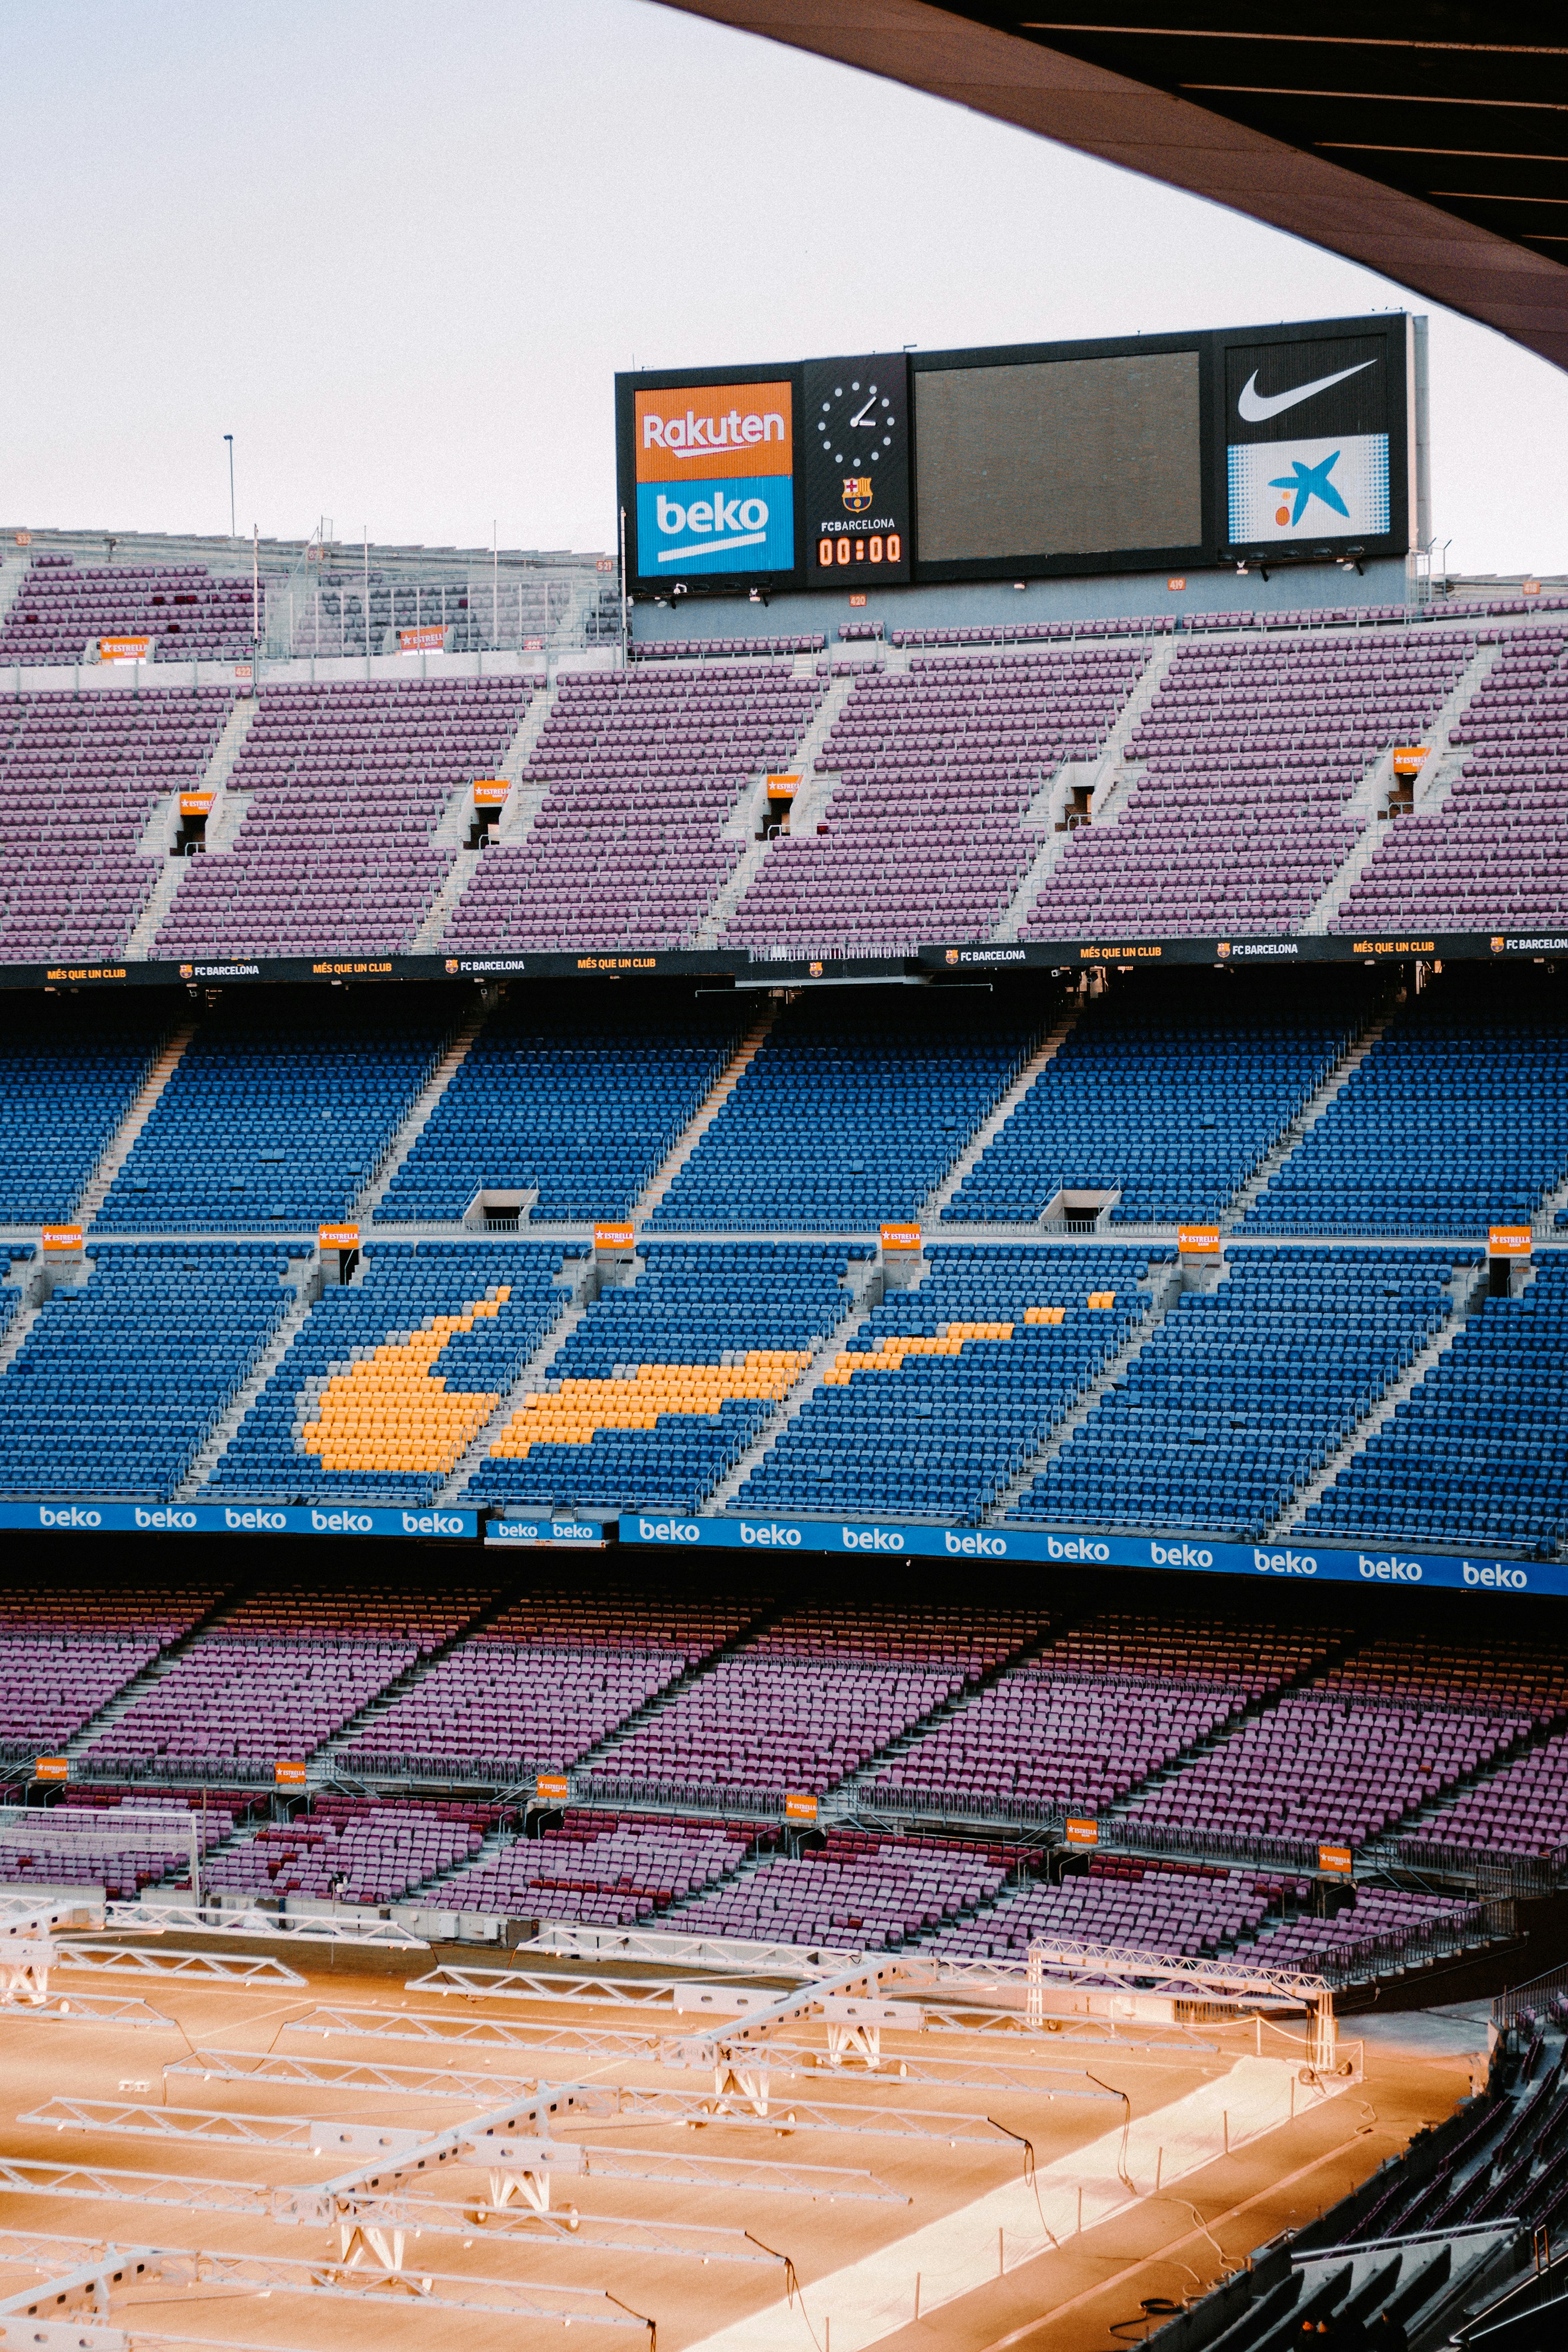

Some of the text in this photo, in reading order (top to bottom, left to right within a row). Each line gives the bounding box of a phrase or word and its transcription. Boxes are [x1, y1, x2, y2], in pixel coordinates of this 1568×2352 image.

[643, 410, 784, 449] Rakuten
[657, 492, 769, 534] beko
[820, 534, 900, 566] 00:00
[1169, 580, 1183, 589] 419
[851, 596, 865, 606] 420
[236, 667, 251, 676] 422
[1081, 946, 1161, 959] MÉS QUE UN CLUB
[1233, 944, 1298, 955] FC BARCELONA
[1353, 940, 1435, 954] MÉS QUE UN CLUB
[1507, 938, 1568, 949] FC BARCELON
[460, 960, 524, 971] FC BARCELONA
[577, 957, 656, 970] MÉS QUE UN CLUB
[961, 950, 1025, 961] FC BARCELONA
[47, 968, 126, 981] MÉS QUE UN CLUB
[195, 965, 259, 975] FC BARCELONA
[313, 962, 392, 974] MÉS QUE UN CLUB
[40, 1506, 102, 1527] beko
[135, 1508, 197, 1528] beko
[225, 1508, 286, 1529] beko
[311, 1510, 373, 1531] beko
[402, 1512, 463, 1534] beko
[499, 1523, 538, 1538] beko
[553, 1523, 593, 1538] beko
[639, 1518, 700, 1542] beko
[740, 1523, 801, 1546] beko
[842, 1527, 904, 1551] beko
[945, 1531, 1007, 1556] beko
[1048, 1536, 1110, 1561] beko
[1151, 1542, 1213, 1567] beko
[1254, 1548, 1318, 1575] beko
[1359, 1555, 1422, 1581] beko
[1463, 1561, 1527, 1589] beko
